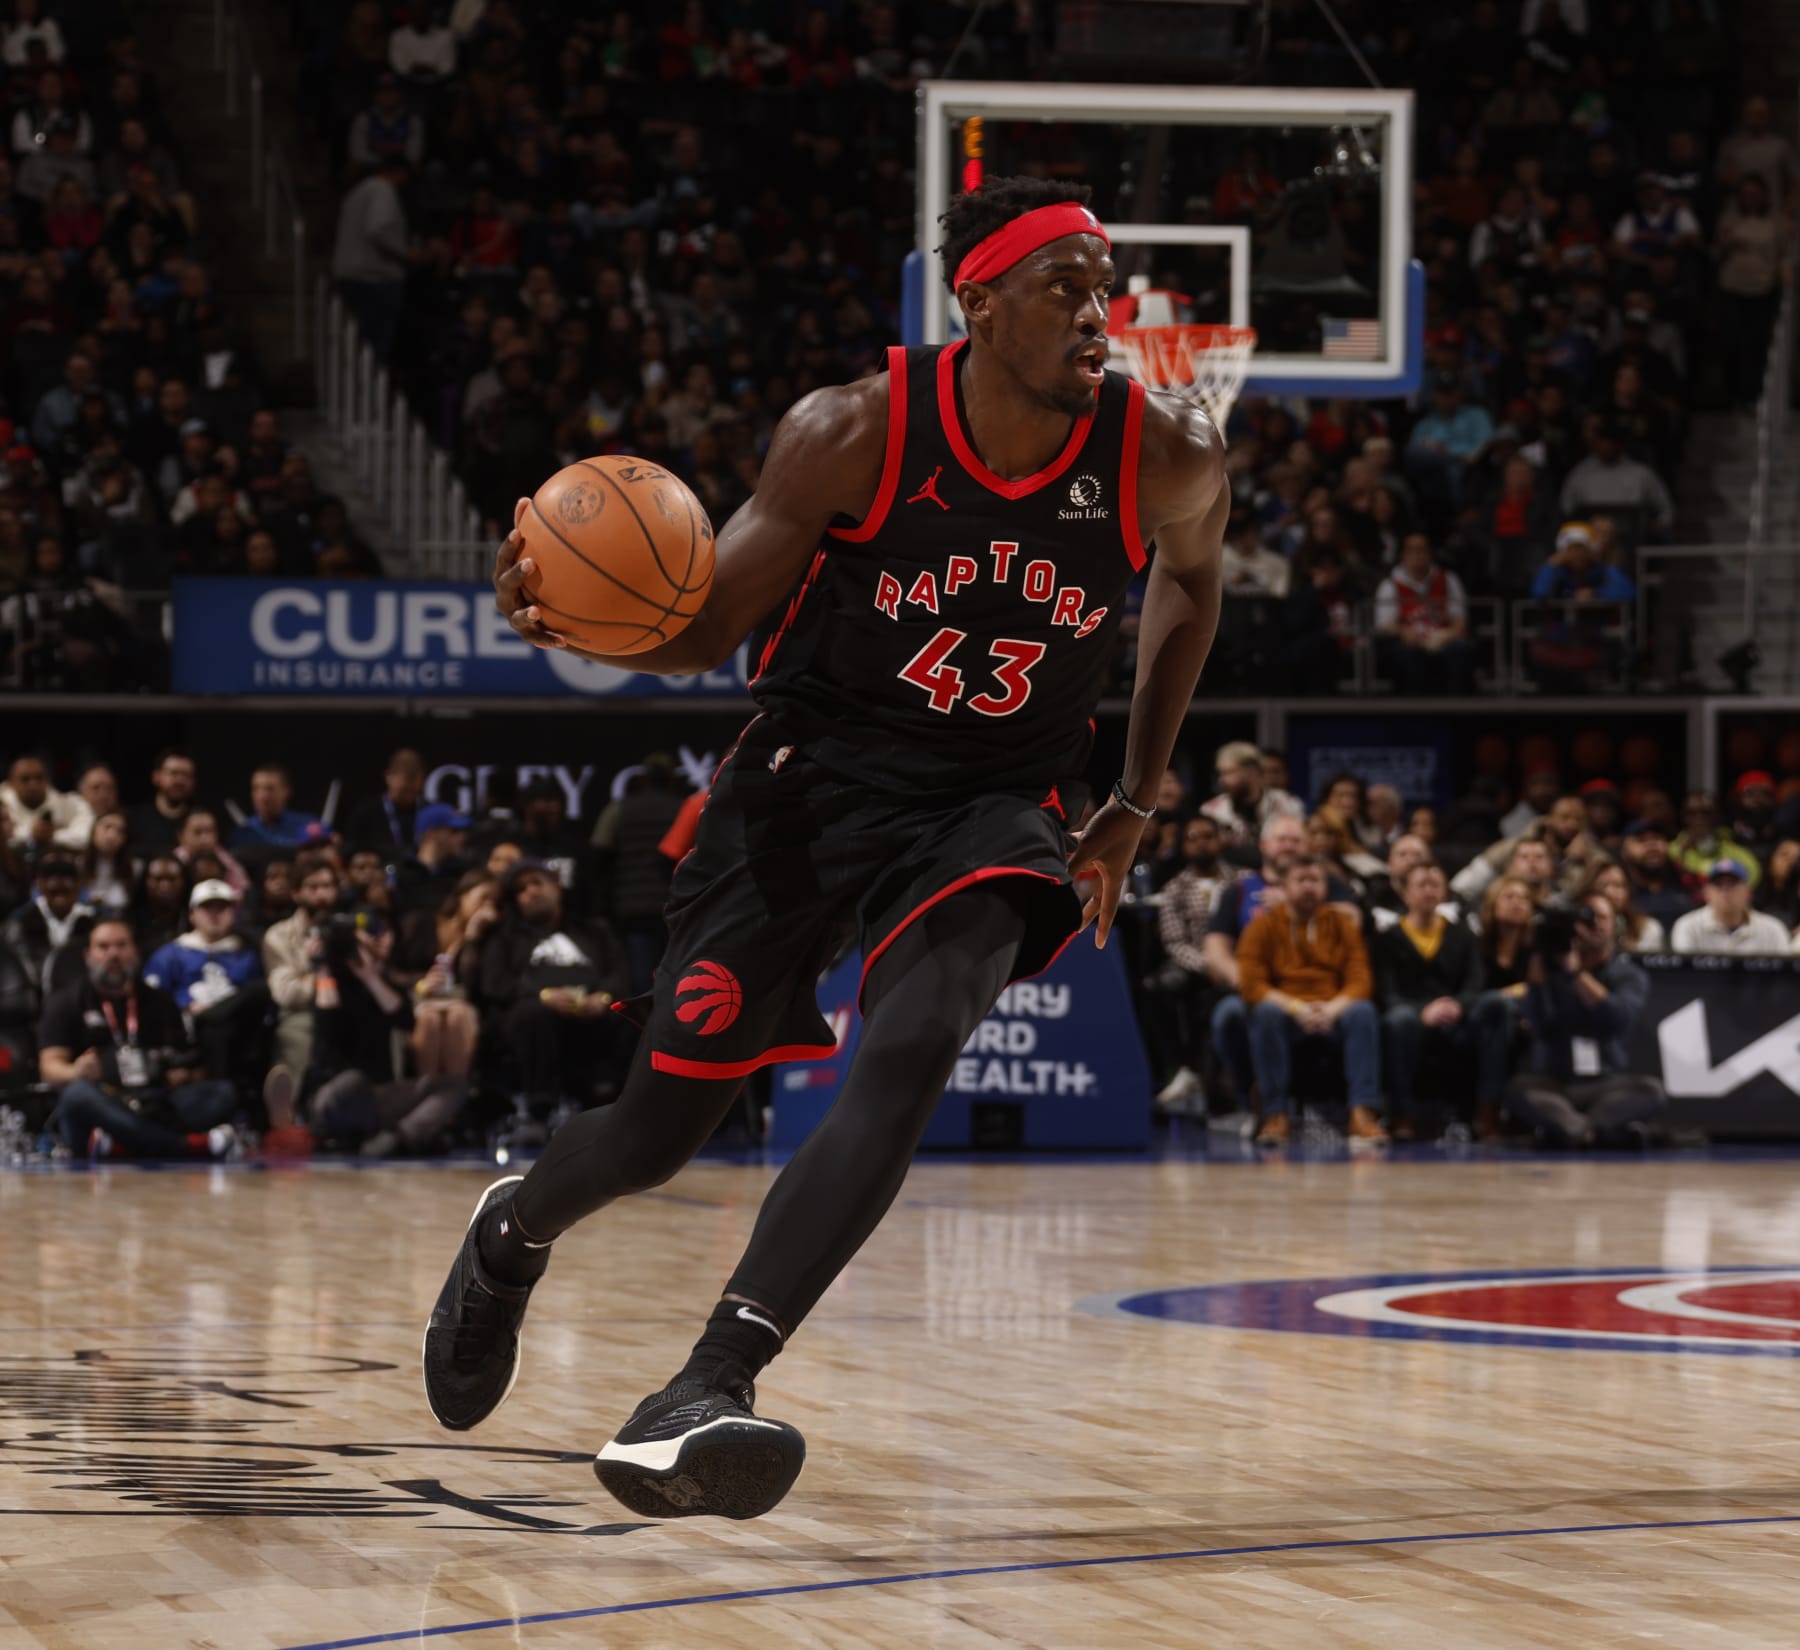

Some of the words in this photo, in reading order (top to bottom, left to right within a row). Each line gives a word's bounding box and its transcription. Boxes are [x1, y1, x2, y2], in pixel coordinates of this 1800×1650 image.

[1058, 509, 1083, 520] Sun
[1086, 507, 1109, 519] Life
[249, 588, 534, 661] CURE
[873, 540, 1109, 640] RAPTORS
[253, 660, 463, 688] INSURANCE
[897, 627, 1047, 718] 43
